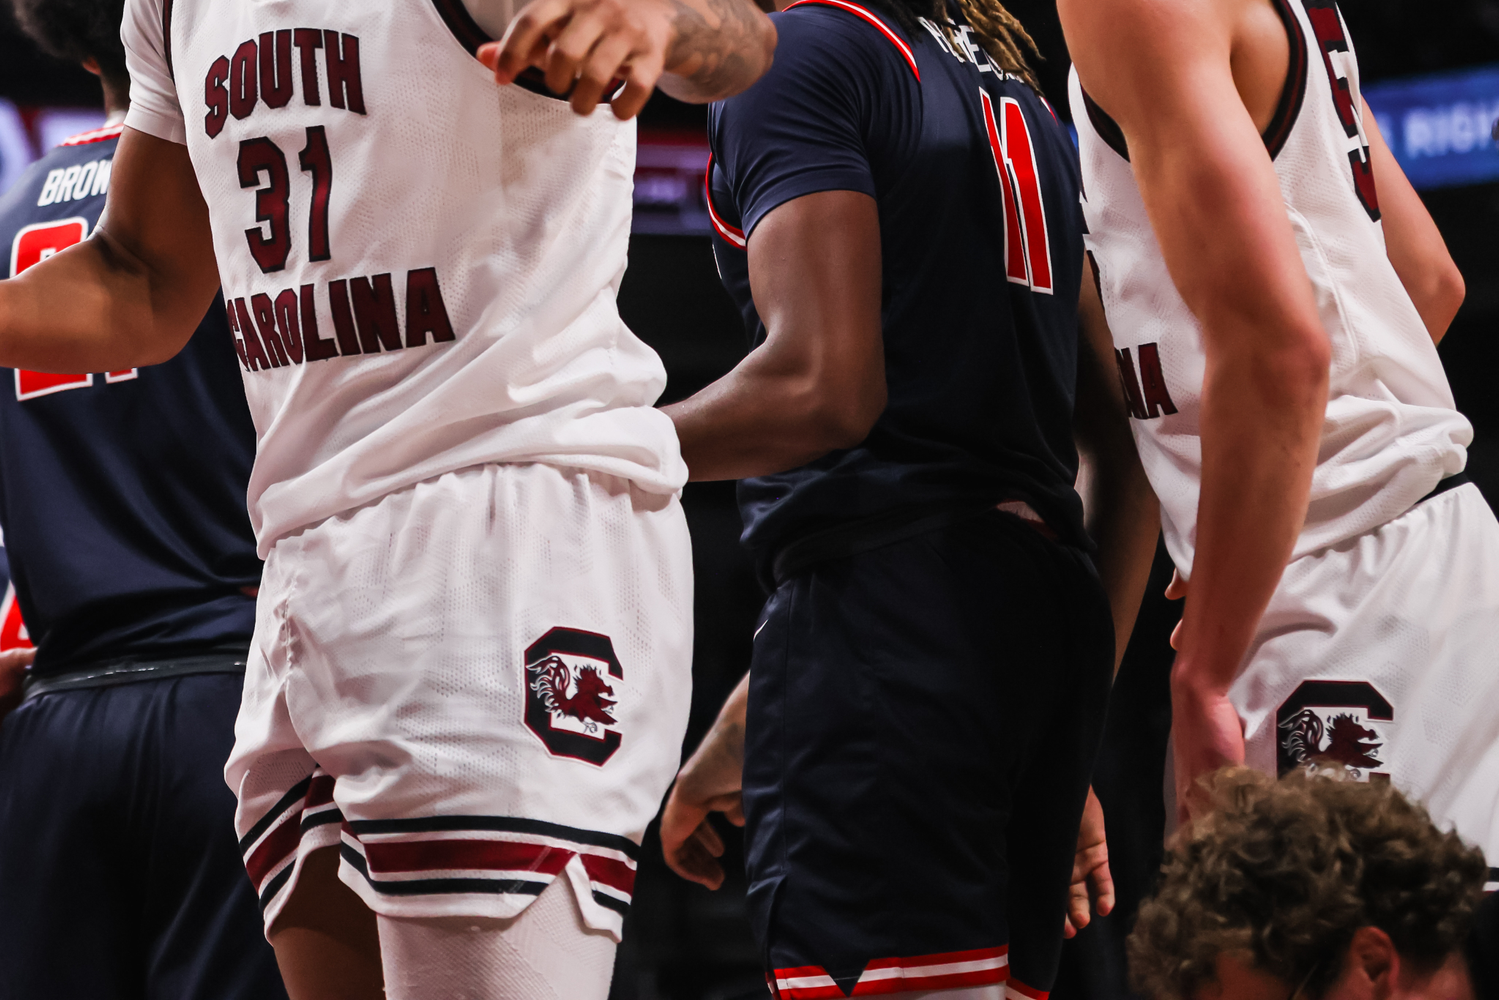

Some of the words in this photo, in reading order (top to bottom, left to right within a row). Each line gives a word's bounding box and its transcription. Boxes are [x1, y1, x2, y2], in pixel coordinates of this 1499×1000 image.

[204, 26, 367, 140] SOUTH
[236, 125, 333, 275] 31
[978, 86, 1054, 296] 11
[225, 266, 457, 373] CAROLINA
